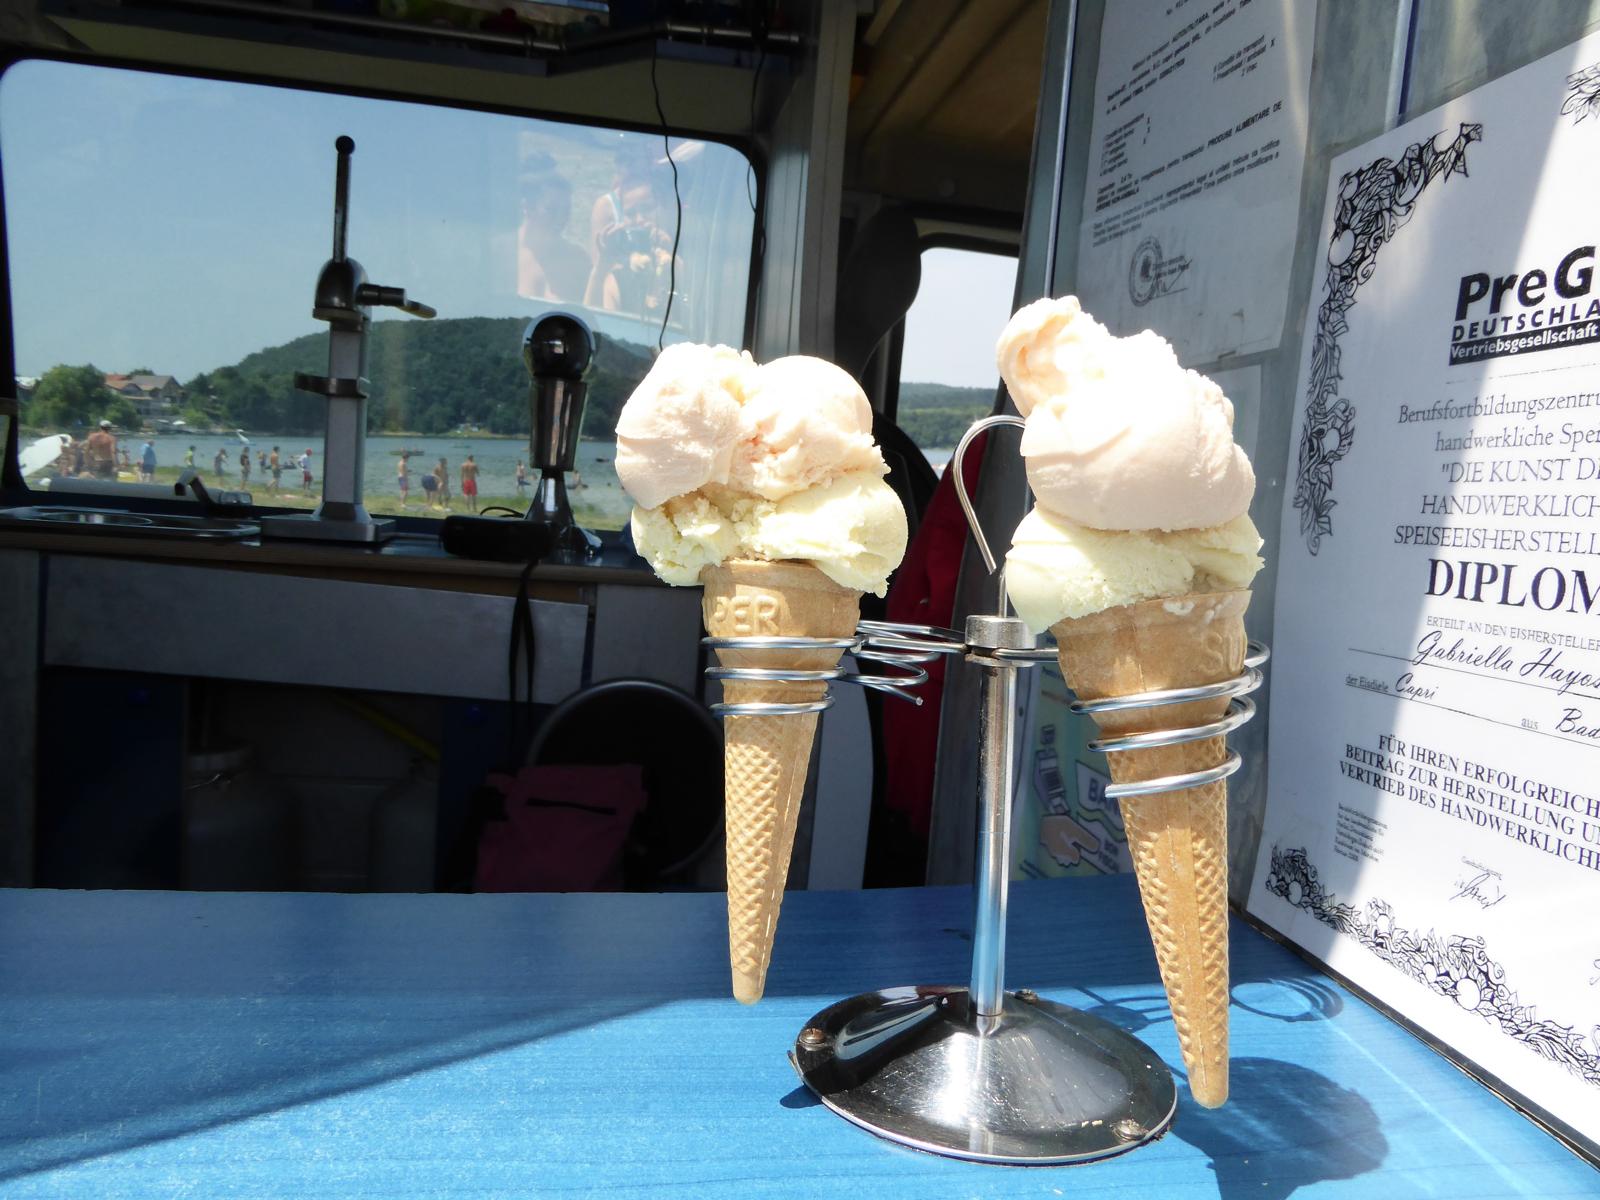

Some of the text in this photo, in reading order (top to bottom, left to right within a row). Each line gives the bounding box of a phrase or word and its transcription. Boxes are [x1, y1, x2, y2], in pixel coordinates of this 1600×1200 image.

[1234, 106, 1270, 134] ALIMENTARE
[1272, 99, 1283, 113] DE
[1454, 245, 1597, 321] PreG
[1450, 322, 1598, 361] Vertriebsgesellschaft
[1434, 425, 1554, 452] handwerkliche
[1441, 461, 1483, 484] "DIE
[1488, 459, 1572, 484] KUNST
[1424, 558, 1600, 616] DIPLOM
[1426, 615, 1466, 632] ERTEILT
[1468, 622, 1483, 634] AN
[1484, 623, 1508, 637] DEN
[1412, 630, 1514, 671] Gabriella
[1395, 672, 1439, 701] Capri
[1521, 716, 1539, 730] aus
[1378, 733, 1406, 757] FÜR
[1410, 744, 1461, 772] IHREN
[1340, 760, 1405, 797] VERTRIEB
[1409, 785, 1437, 810] DES
[1345, 743, 1600, 846] BEITRAG ZUR HERSTELLUNG U
